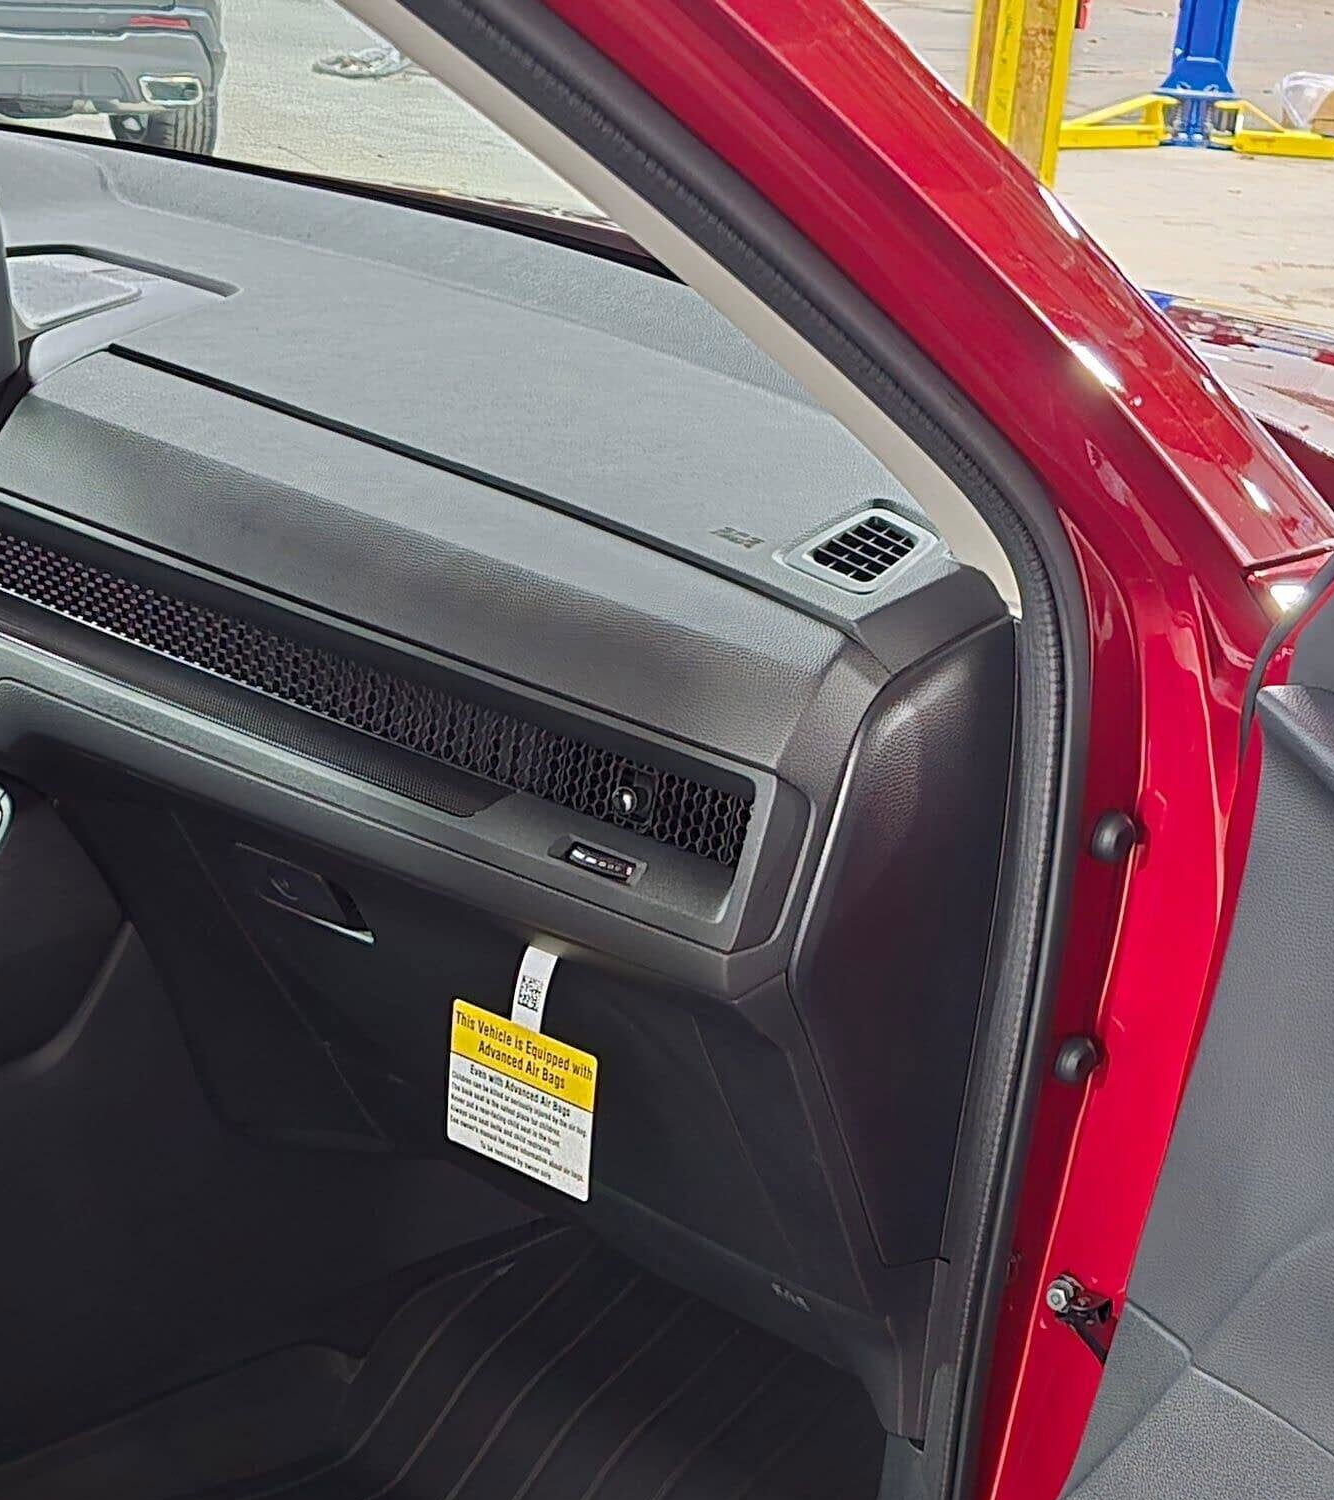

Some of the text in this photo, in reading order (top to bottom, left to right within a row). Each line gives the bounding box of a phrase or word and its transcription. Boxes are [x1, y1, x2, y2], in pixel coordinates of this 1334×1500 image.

[455, 1010, 593, 1081] This Vehicle is Equipped with
[478, 1040, 565, 1091] Advanced Air Bags
[470, 1064, 570, 1118] Even with Advanced Air Bags
